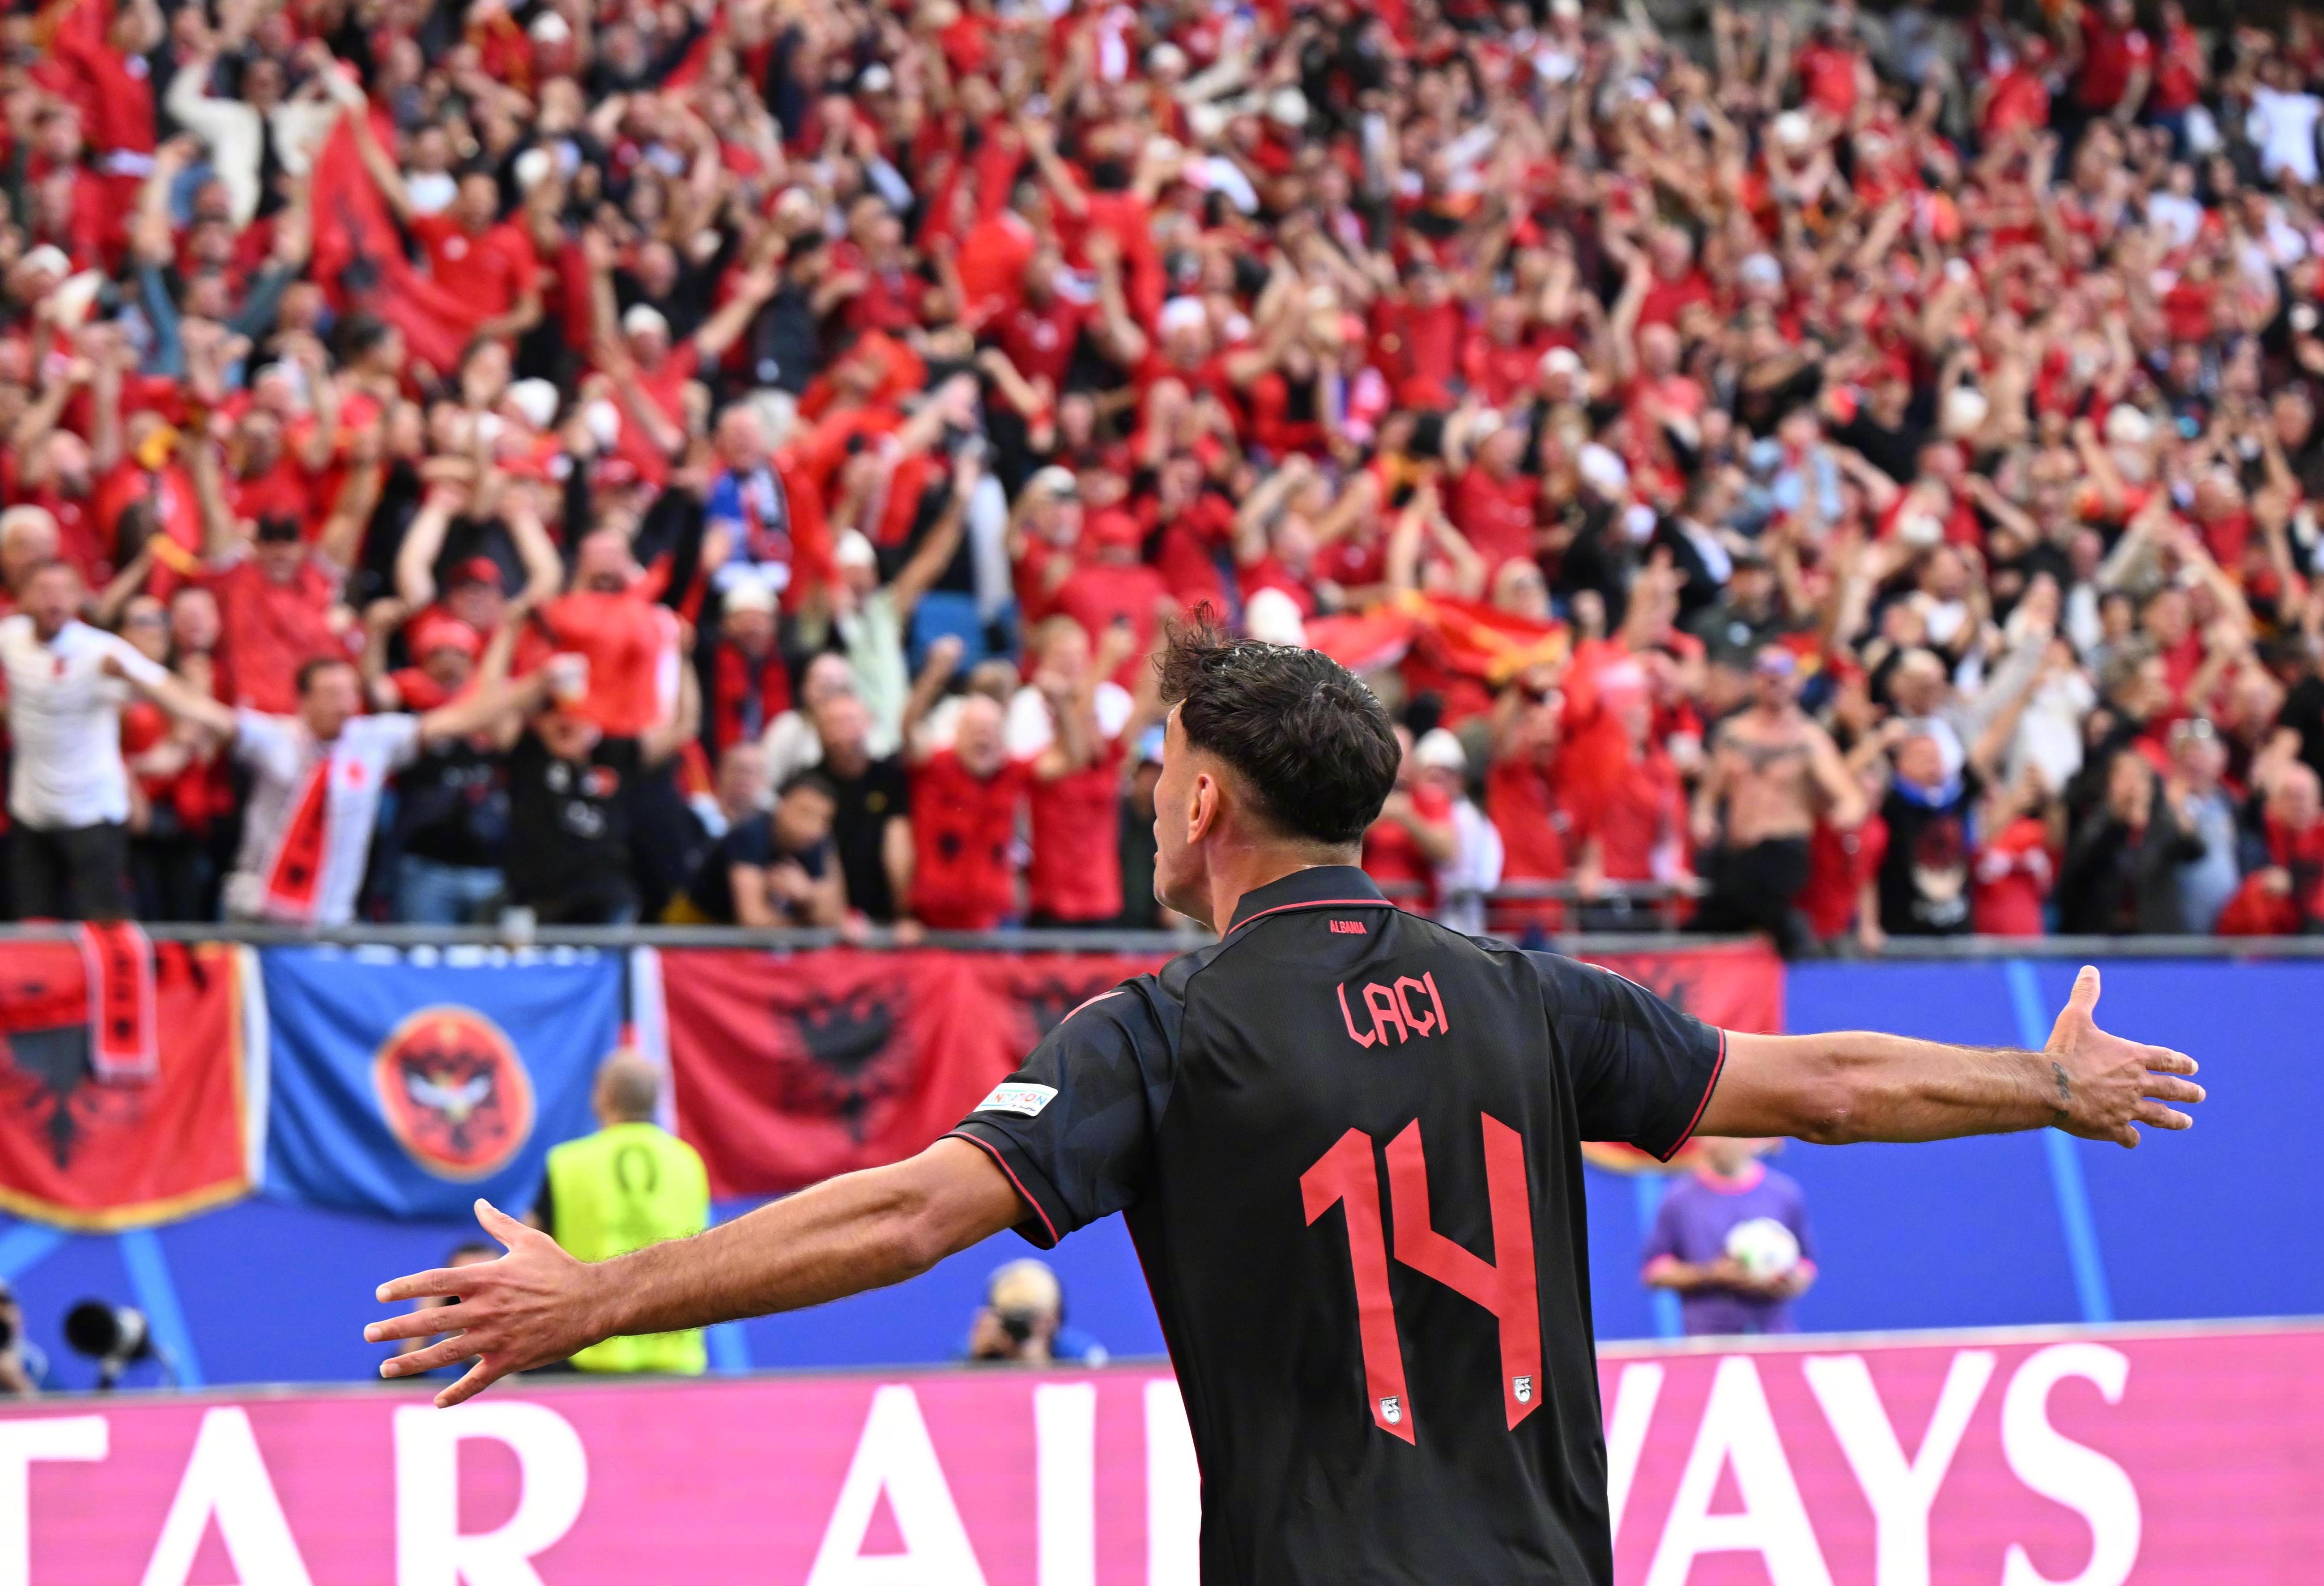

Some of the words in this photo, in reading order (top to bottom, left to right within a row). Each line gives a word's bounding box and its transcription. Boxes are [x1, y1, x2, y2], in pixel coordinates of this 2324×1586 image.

[1330, 920, 1367, 934] ALBANIA
[1337, 971, 1449, 1049] LAÇI
[1299, 1111, 1542, 1446] 14
